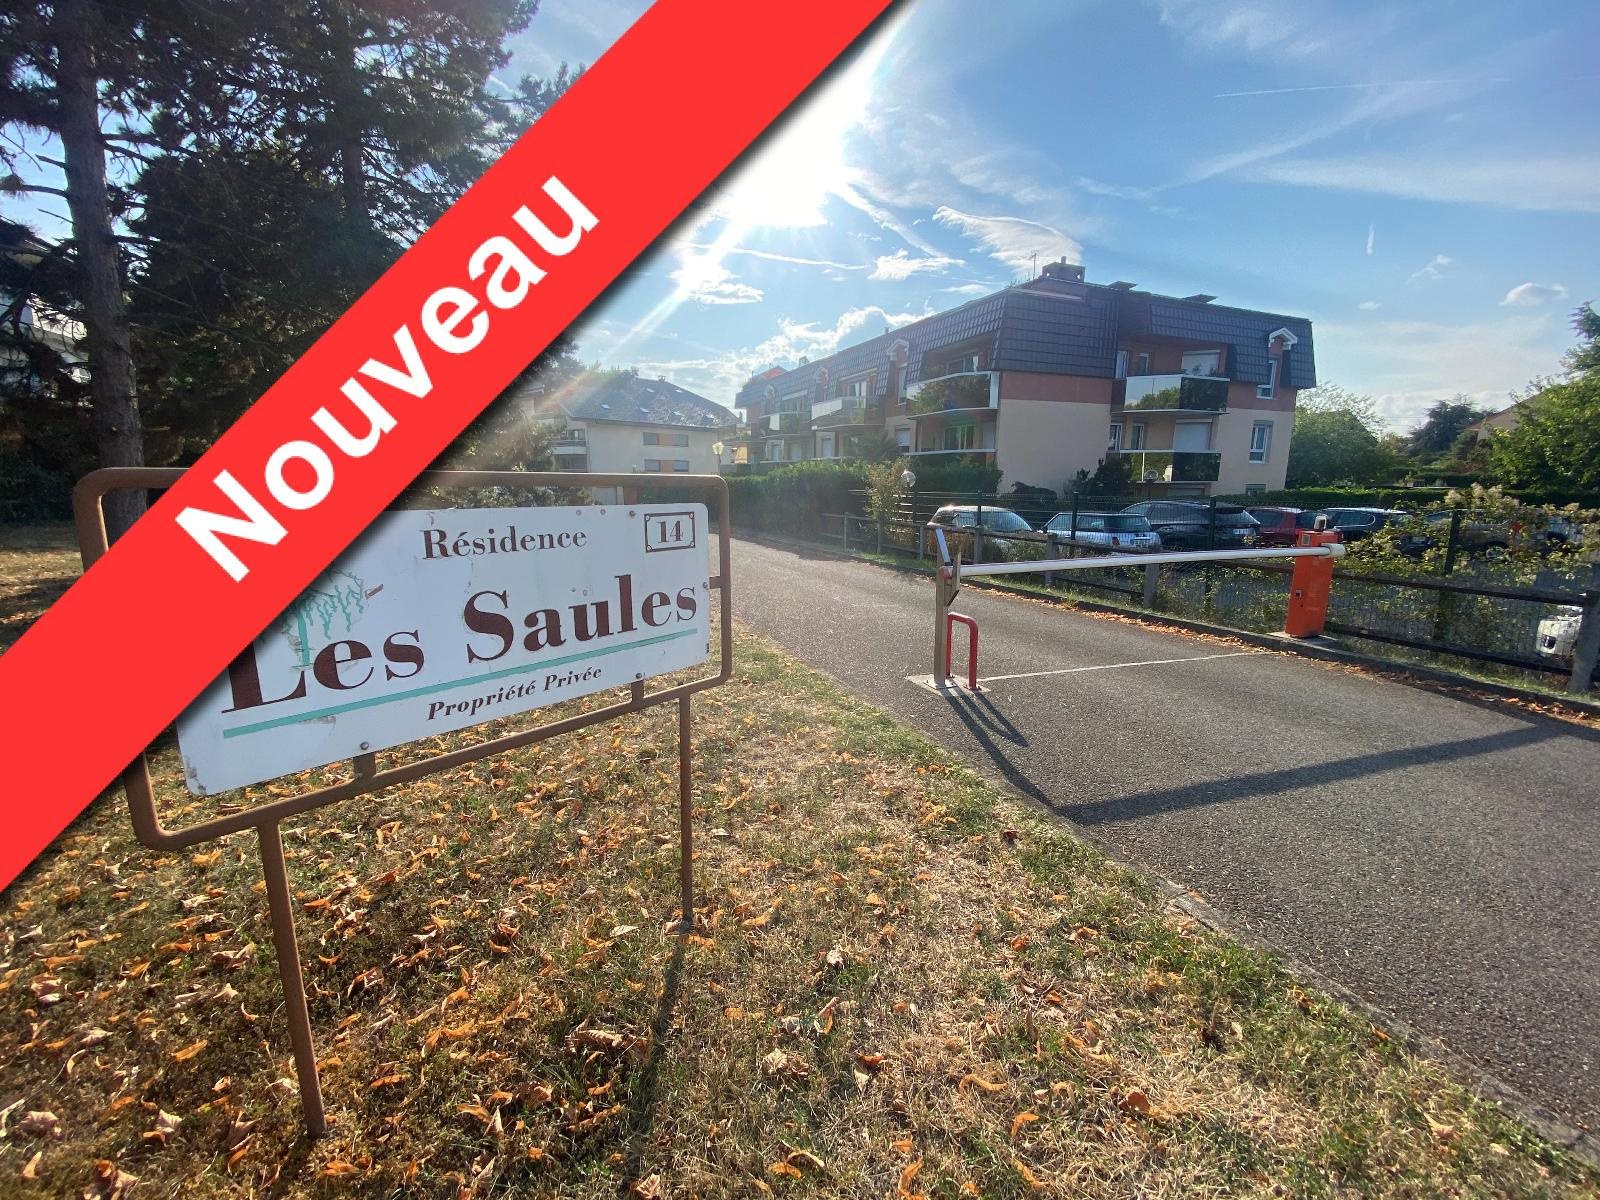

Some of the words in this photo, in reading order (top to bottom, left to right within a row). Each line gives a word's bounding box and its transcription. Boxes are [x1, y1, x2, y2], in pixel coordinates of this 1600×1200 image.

[423, 525, 588, 560] Résidence
[658, 519, 685, 545] 14
[221, 630, 426, 714] Les
[465, 574, 697, 663] Saules
[427, 679, 537, 721] Propriété
[544, 665, 602, 692] Privée
